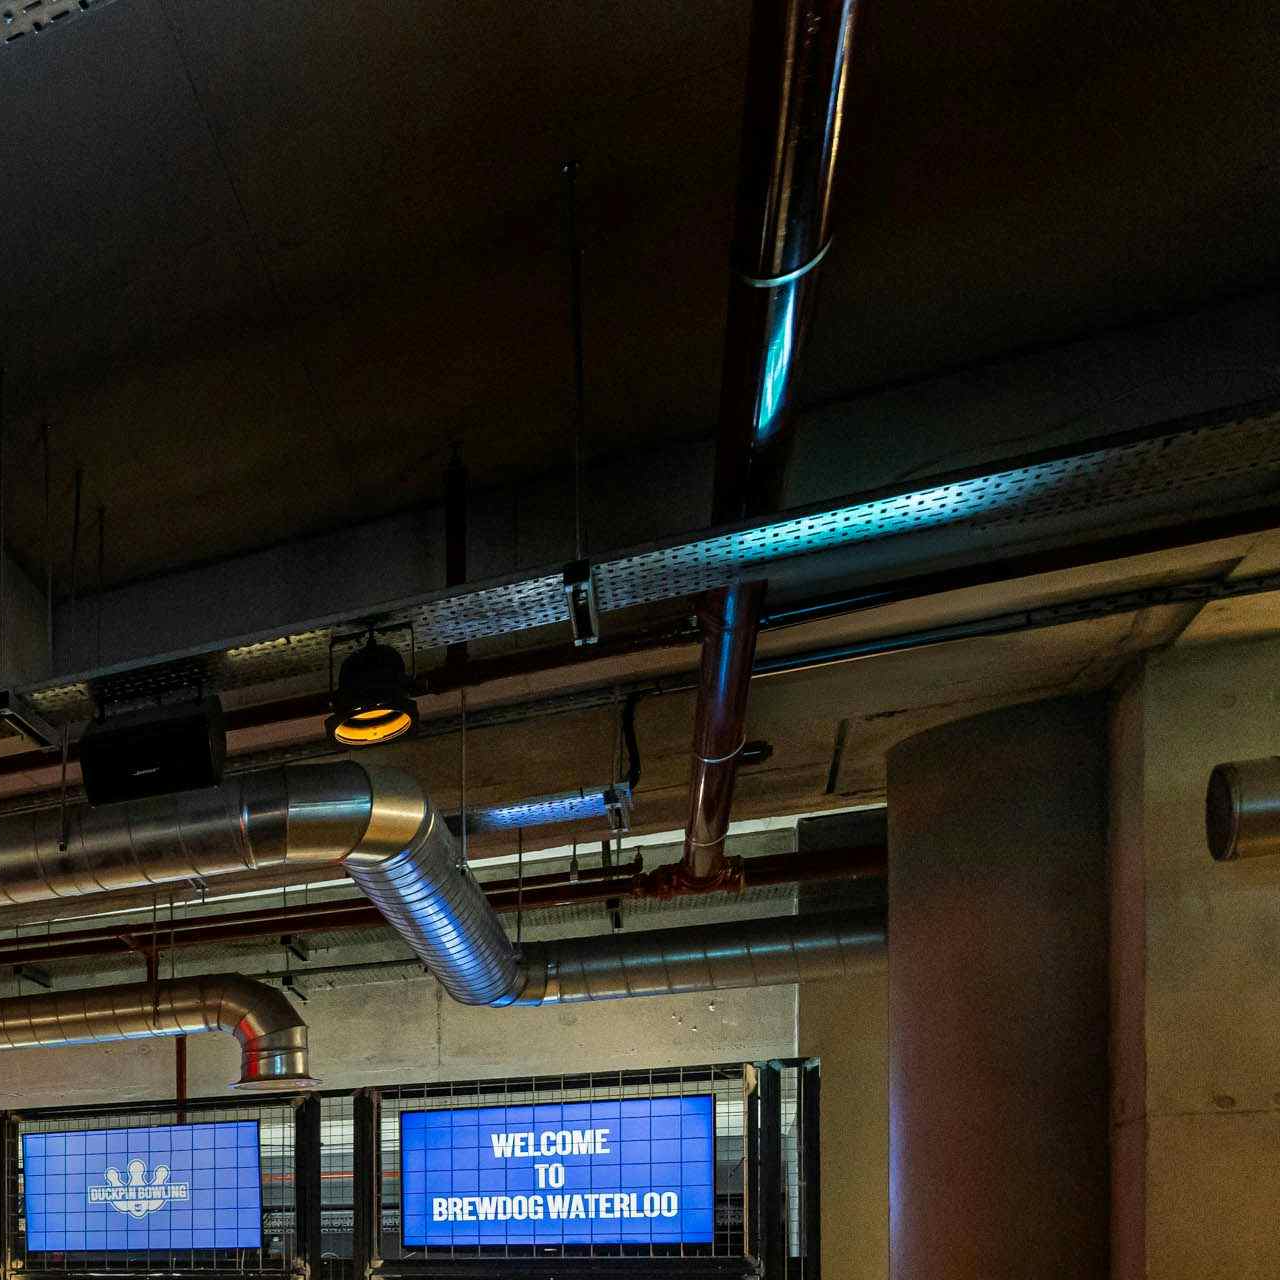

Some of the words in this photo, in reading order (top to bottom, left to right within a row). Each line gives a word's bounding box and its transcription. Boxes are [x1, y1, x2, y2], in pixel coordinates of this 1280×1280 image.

[490, 1128, 611, 1159] WELCOME
[534, 1163, 565, 1189] TO
[90, 1187, 137, 1201] DUCKPIN
[139, 1185, 187, 1199] BOWLING
[432, 1195, 544, 1222] BREWDOG
[546, 1191, 679, 1220] WATERLOO
